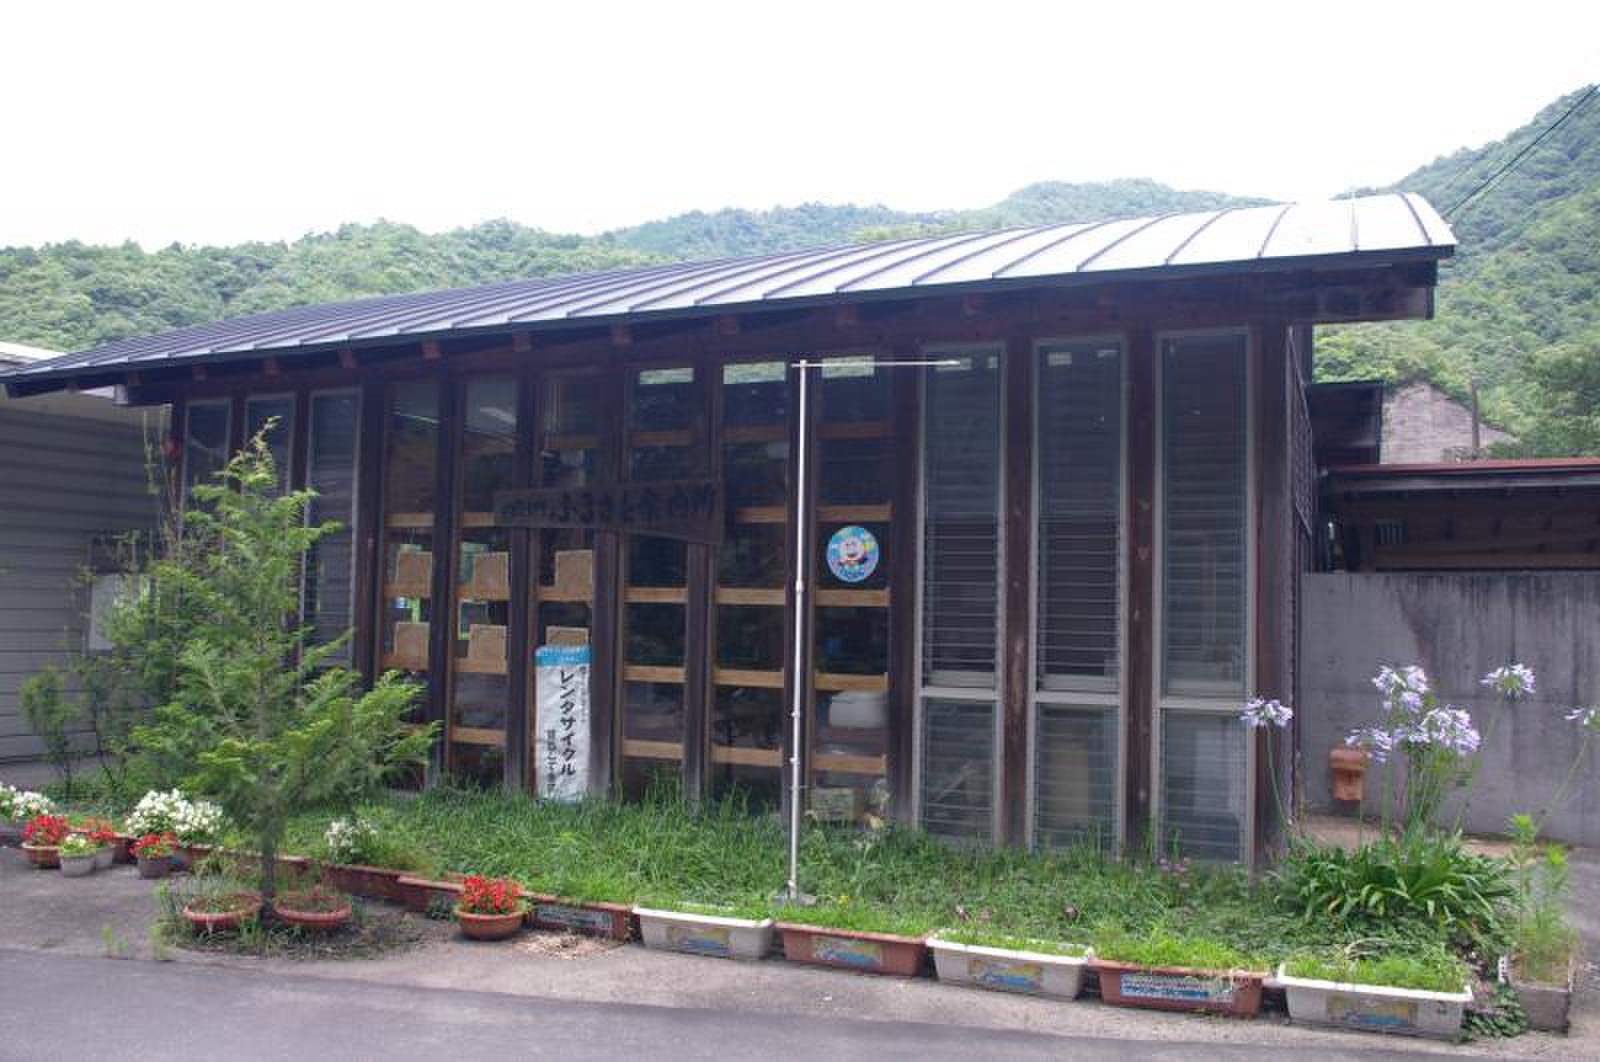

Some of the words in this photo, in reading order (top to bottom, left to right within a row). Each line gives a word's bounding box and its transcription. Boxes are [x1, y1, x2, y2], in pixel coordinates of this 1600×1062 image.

[560, 669, 577, 777] レンタサイクル
